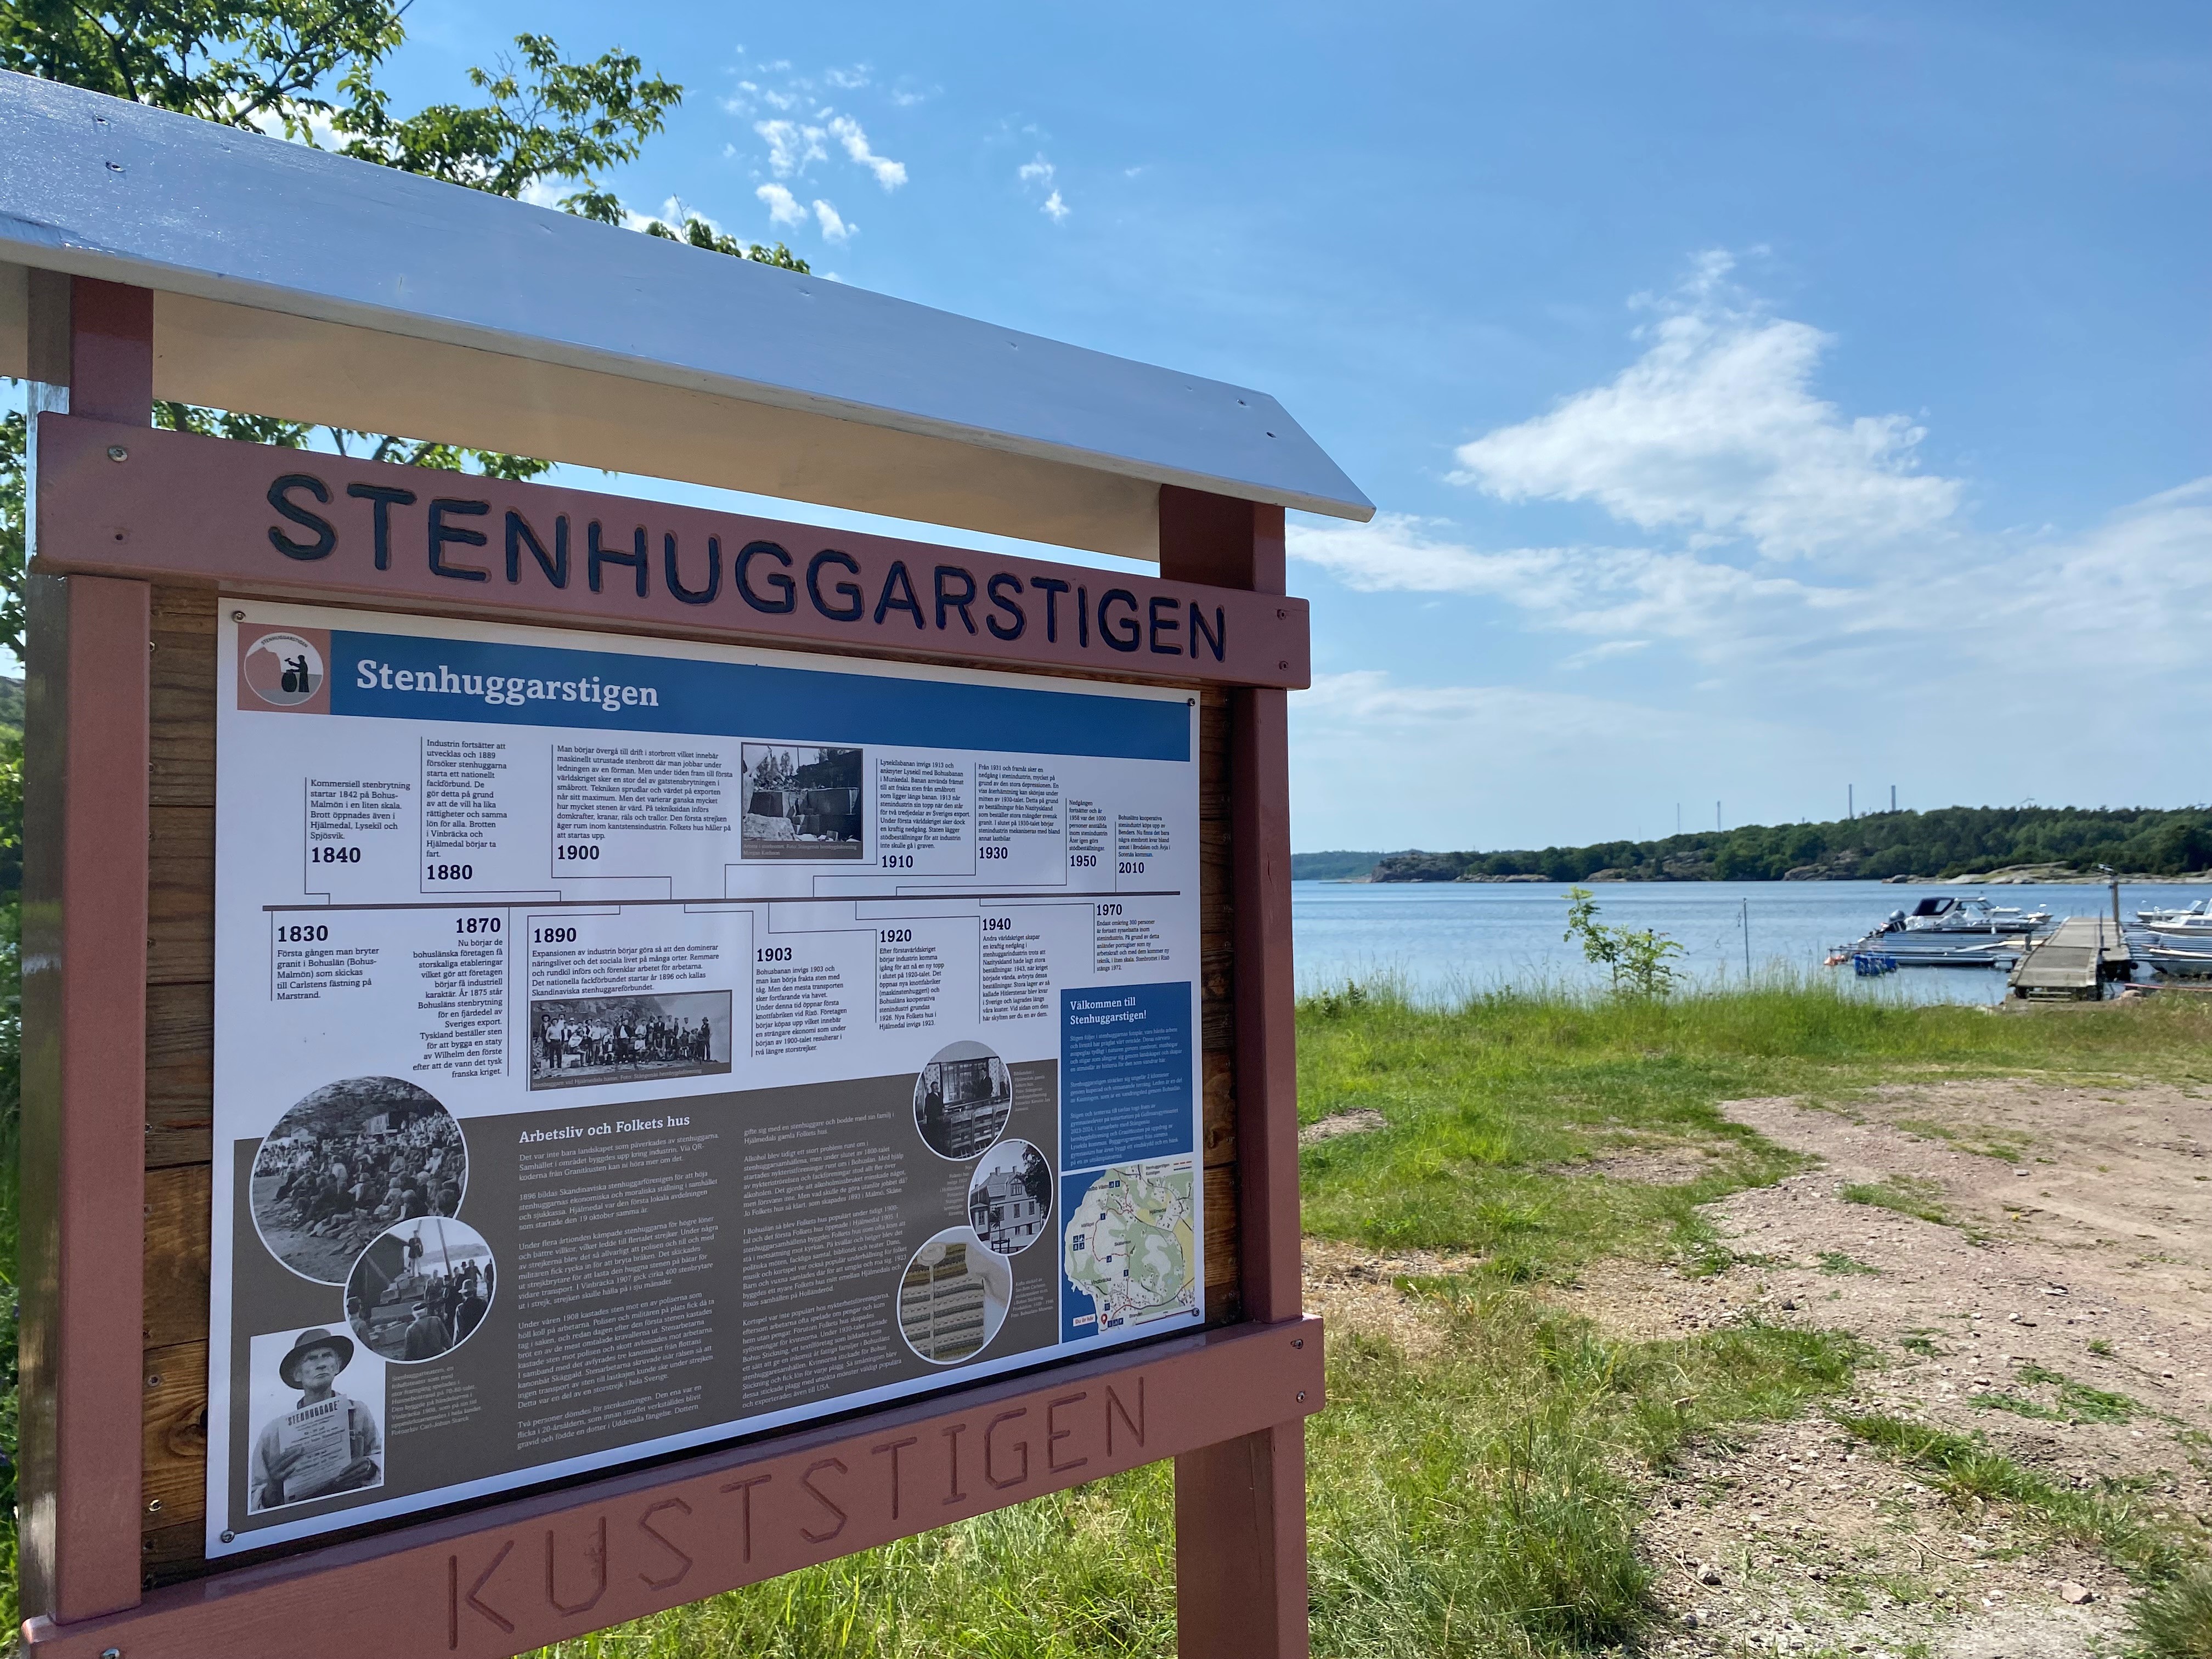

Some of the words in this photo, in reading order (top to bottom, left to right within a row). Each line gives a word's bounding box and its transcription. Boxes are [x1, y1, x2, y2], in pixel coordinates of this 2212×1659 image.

[267, 473, 1228, 661] STENHUGGARSTIGEN
[356, 659, 659, 712] Stenhuggarstigen
[427, 738, 460, 747] Industrin
[461, 740, 494, 748] fortsätter
[427, 749, 461, 757] utvecklas
[462, 749, 476, 758] och
[479, 749, 495, 758] 1889
[574, 745, 594, 755] börjar
[596, 746, 618, 756] övergå
[695, 750, 718, 758] innebär
[427, 759, 457, 767] försöker
[459, 760, 506, 770] stenhuggarna
[880, 758, 915, 766] Lysekilsbanan
[916, 760, 930, 769] invigs
[461, 770, 495, 778] nationellt
[311, 778, 360, 787] Kommersiell
[362, 780, 410, 791] stenbrytning
[340, 789, 357, 798] 1842
[359, 790, 369, 800] på
[371, 790, 398, 798] Bohus-
[311, 799, 343, 808] Malmön
[311, 810, 330, 818] Brott
[332, 810, 370, 820] öppnades
[311, 820, 352, 831] Hjälmedal,
[355, 821, 381, 831] Lysekil
[312, 847, 361, 863] 1840
[557, 845, 600, 860] 1900
[979, 847, 1008, 859] 1930
[882, 855, 913, 868] 1910
[1070, 855, 1097, 867] 1950
[427, 864, 473, 880] 1880
[1119, 862, 1144, 874] 2010
[1097, 904, 1122, 916] 1970
[456, 917, 501, 933] 1870
[983, 918, 1011, 931] 1940
[278, 925, 328, 943] 1830
[534, 927, 577, 943] 1890
[880, 929, 912, 943] 1920
[470, 938, 492, 947] börjar
[277, 948, 302, 956] Första
[304, 947, 334, 958] gången
[356, 946, 379, 957] bryter
[413, 949, 458, 957] bohuslänska
[460, 949, 494, 958] företagen
[496, 947, 503, 956] få
[532, 949, 575, 958] Expansionen
[617, 946, 637, 955] börjar
[639, 945, 653, 955] göra
[757, 947, 792, 962] 1903
[893, 945, 935, 954] förstavärldskriget
[277, 959, 301, 969] granit
[308, 957, 345, 966] Bohuslän
[347, 957, 376, 968] (Bohus-
[419, 959, 458, 969] storskaliga
[460, 958, 503, 968] etableringar
[879, 955, 895, 963] börjar
[277, 968, 313, 979] Malmön)
[335, 968, 363, 976] skickas
[421, 969, 441, 977] vilket
[443, 968, 455, 979] gör
[469, 968, 503, 978] företagen
[792, 966, 809, 975] invigs
[277, 979, 287, 989] till
[290, 979, 327, 988] Carlstens
[329, 978, 360, 989] fästning
[362, 977, 371, 989] på
[532, 985, 579, 995] Skandinaviska
[1070, 1000, 1122, 1011] Välkommen
[1124, 996, 1136, 1007] till
[1070, 1007, 1147, 1025] Stenhuggarstigen!
[518, 1127, 584, 1143] Arbetsliv
[588, 1122, 612, 1136] och
[616, 1118, 663, 1133] Folkets
[667, 1115, 690, 1127] hus
[578, 1144, 613, 1154] landskapet
[630, 1138, 666, 1150] påverkades
[449, 1375, 1145, 1650] KUSTSTIGEN
